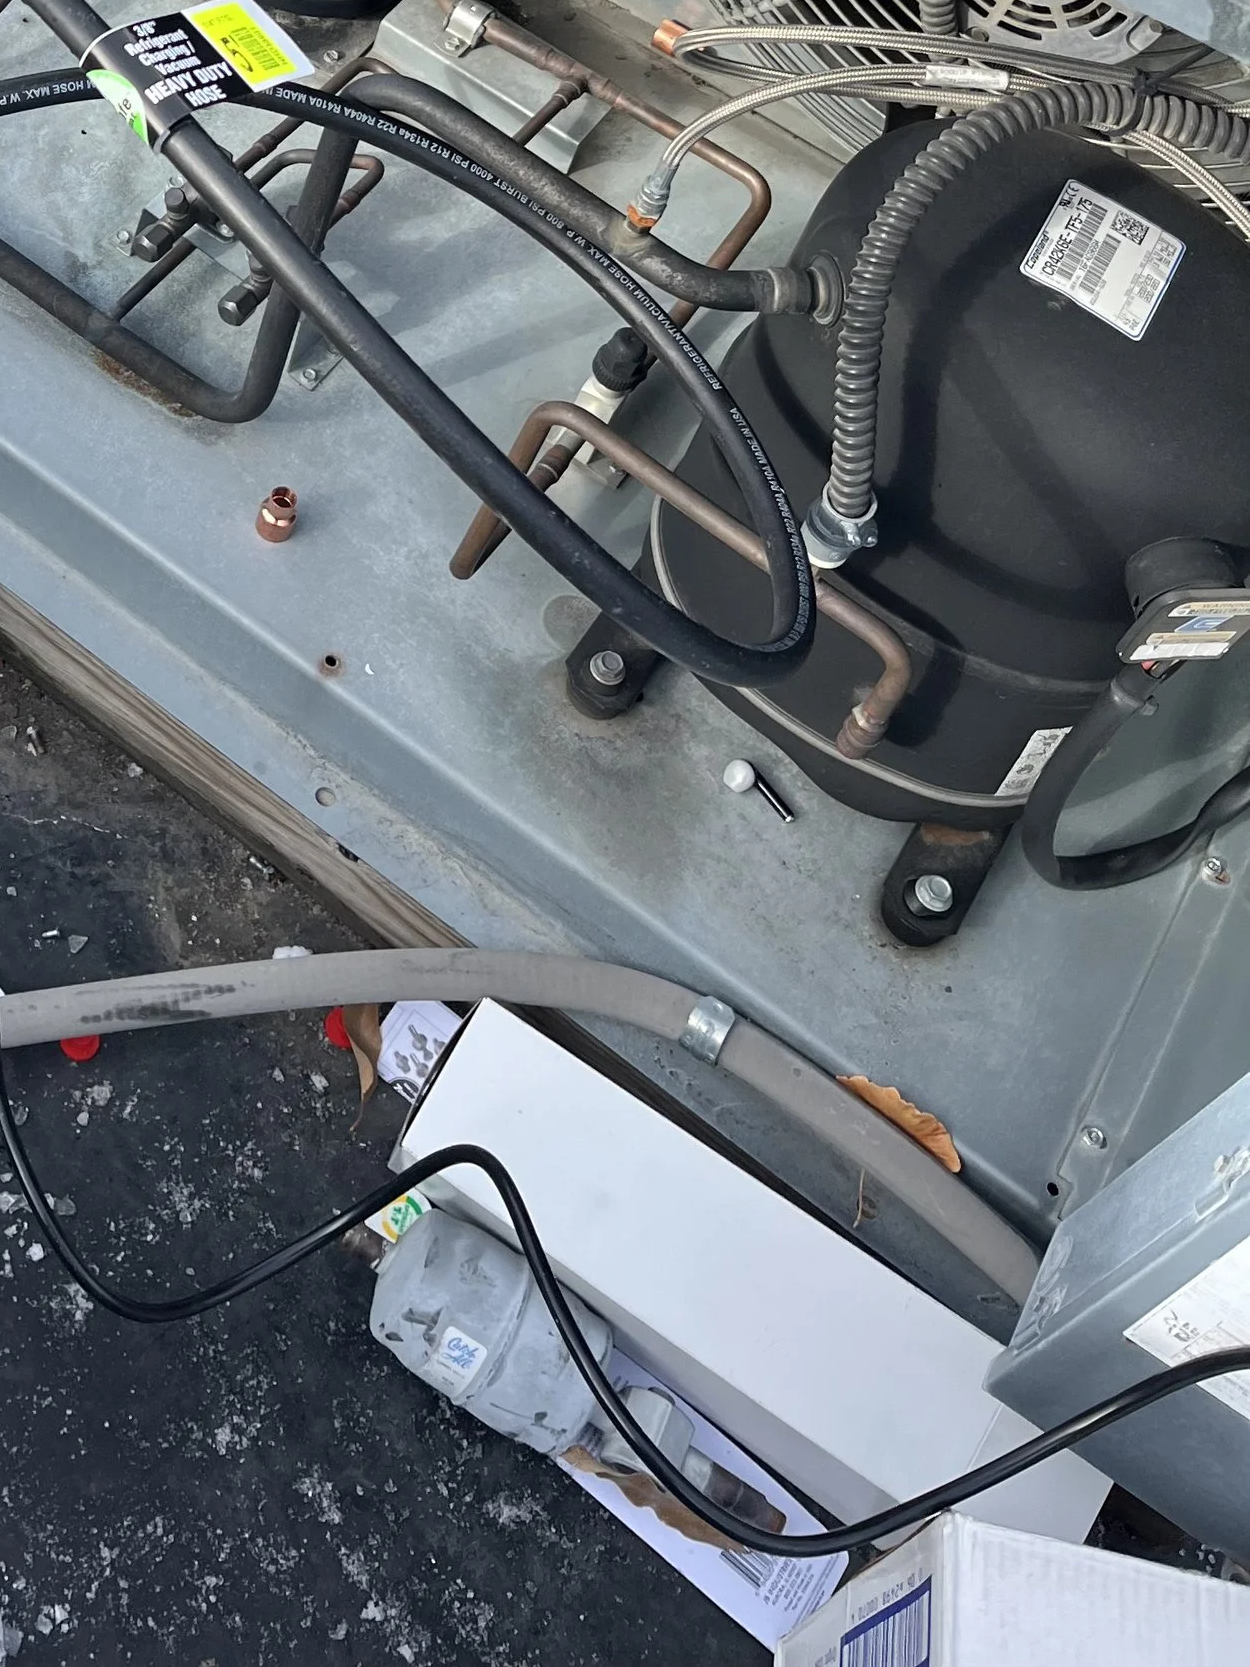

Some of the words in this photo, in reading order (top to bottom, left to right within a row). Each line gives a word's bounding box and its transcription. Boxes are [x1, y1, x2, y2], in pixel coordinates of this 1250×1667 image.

[124, 27, 189, 56] Refrigerant
[138, 45, 190, 67] Charging
[154, 56, 201, 77] Vacuum
[52, 81, 84, 94] HOSE
[144, 69, 196, 104] HEAVY
[196, 61, 233, 85] DUTY
[0, 92, 21, 107] W.P.
[23, 85, 50, 100] MAX.
[185, 84, 227, 108] HOSE
[276, 87, 307, 103] MADE
[307, 96, 341, 114] R410A
[343, 106, 376, 125] R404A
[375, 119, 396, 135] R22
[398, 127, 429, 149] R134a
[429, 143, 450, 159] R12
[449, 152, 469, 169] PSI
[470, 162, 494, 181] 4000
[493, 176, 528, 202] BURST
[529, 200, 546, 217] PSI
[545, 213, 565, 229] 800
[566, 228, 586, 247] W.P.
[1041, 196, 1092, 276] CR42K6E-TF5-175
[1026, 233, 1049, 268] Copeland
[608, 263, 636, 288] HOSE
[633, 283, 721, 390] REFRIGERANT/VACUUM
[729, 407, 743, 426] USA
[740, 427, 751, 440] IN
[747, 438, 766, 466] MADE
[762, 464, 782, 493] R410A
[784, 515, 798, 536] R22
